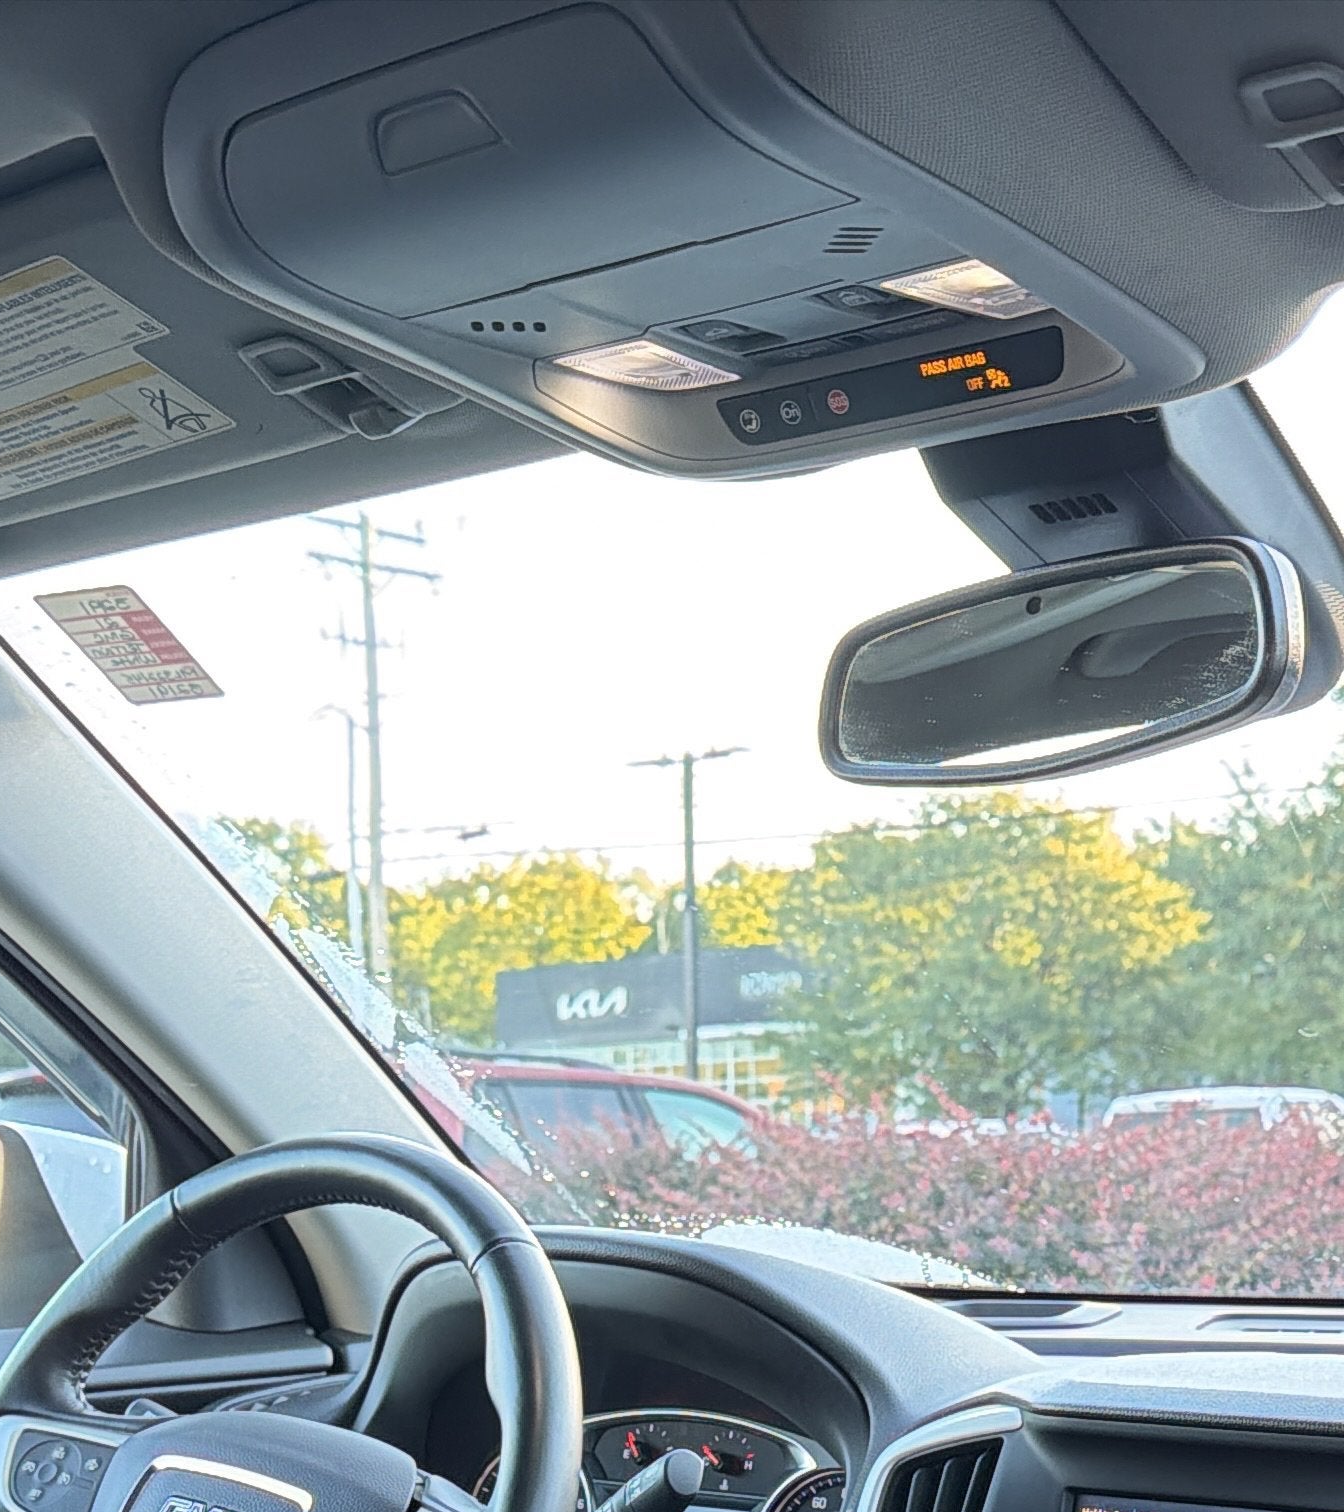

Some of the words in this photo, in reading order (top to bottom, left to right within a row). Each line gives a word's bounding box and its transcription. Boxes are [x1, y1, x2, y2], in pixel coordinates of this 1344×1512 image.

[920, 360, 947, 376] PASS
[948, 356, 966, 372] AIR
[964, 351, 986, 368] BAG
[966, 376, 984, 390] OFF
[744, 1460, 753, 1470] H
[811, 1496, 827, 1510] 60
